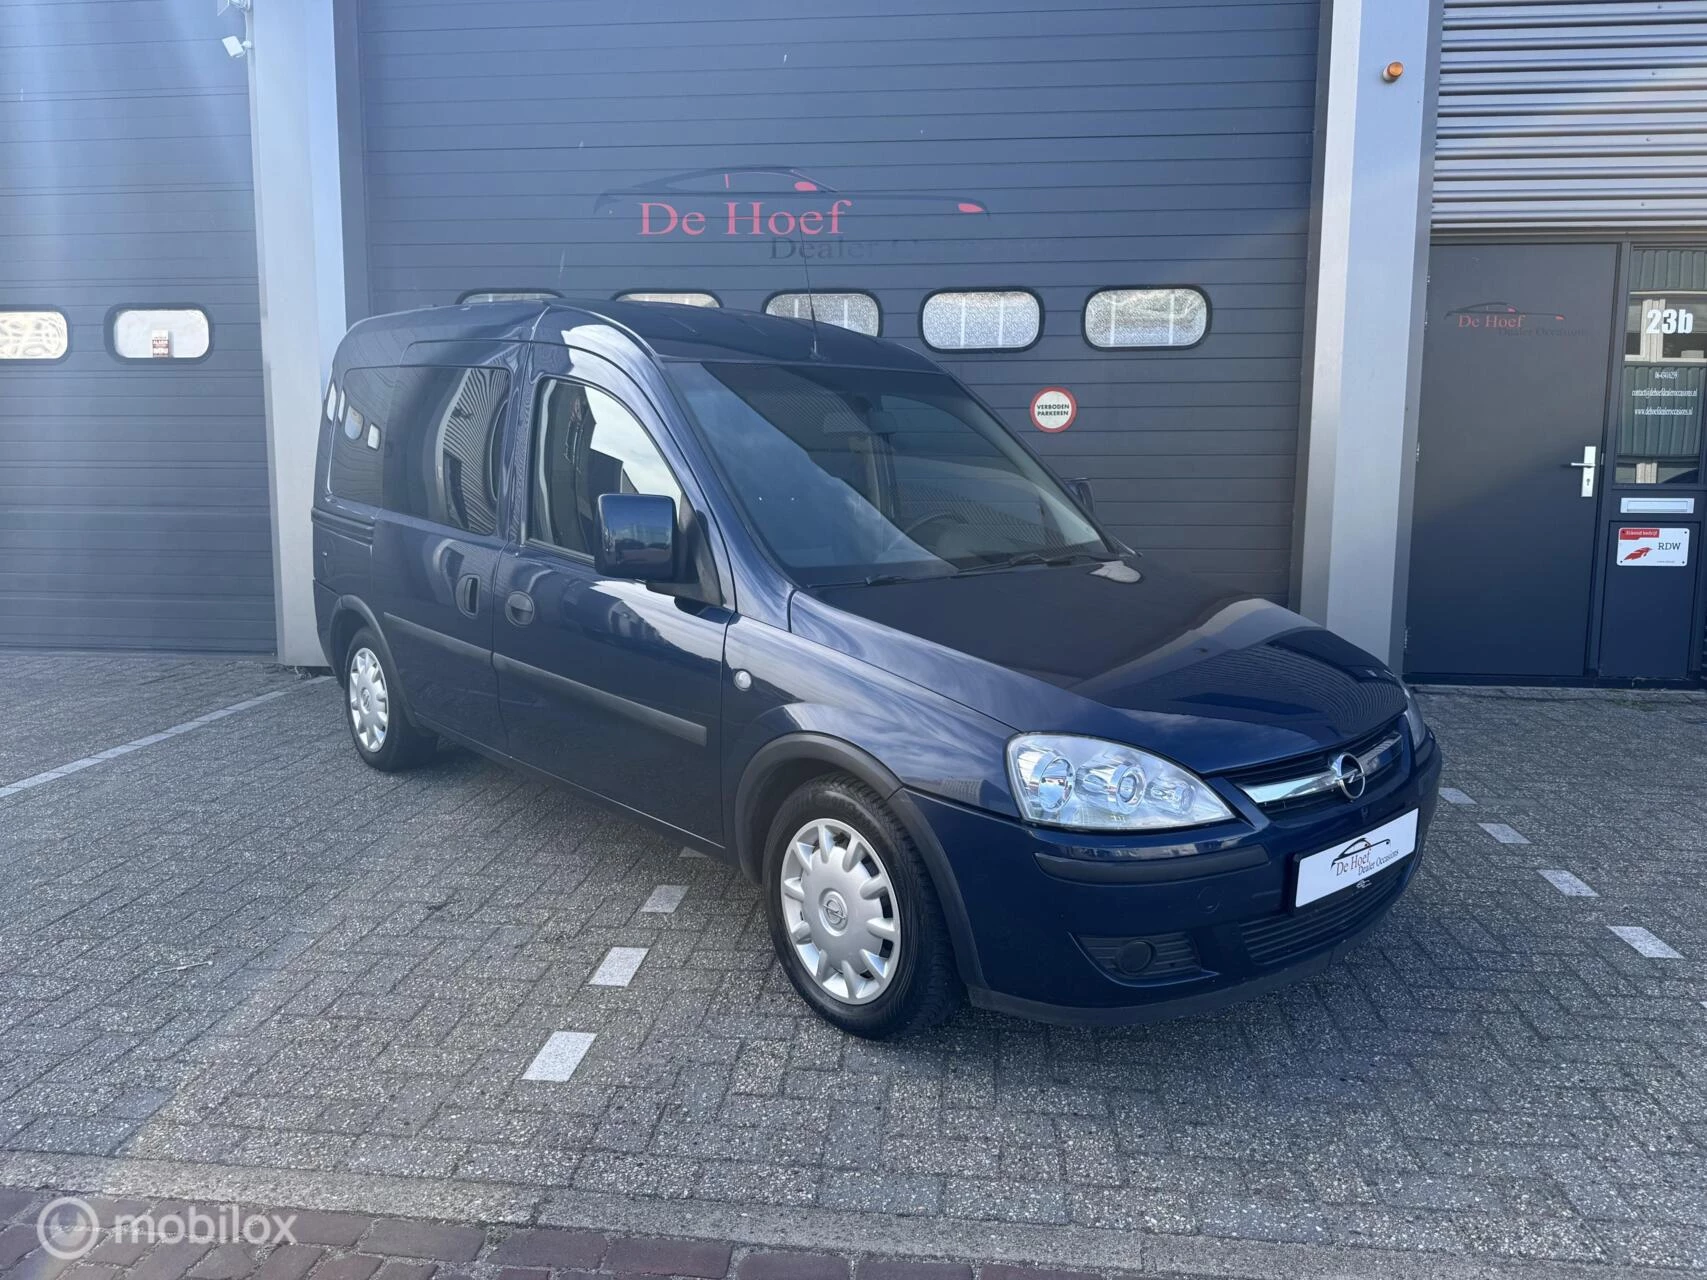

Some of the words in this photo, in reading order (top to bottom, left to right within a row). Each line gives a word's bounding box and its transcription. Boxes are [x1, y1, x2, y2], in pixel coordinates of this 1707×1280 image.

[637, 202, 705, 236] De
[725, 199, 852, 236] Hoef
[769, 236, 878, 259] Dealer
[1458, 314, 1480, 328] De
[1485, 313, 1527, 328] Hoef
[1535, 326, 1586, 337] Occasion
[1646, 308, 1694, 334] 23b
[1658, 542, 1681, 551] RDW
[1336, 860, 1349, 876] De
[1350, 849, 1371, 870] Hoef
[1358, 861, 1376, 876] Dealer
[1376, 850, 1399, 867] Occasions
